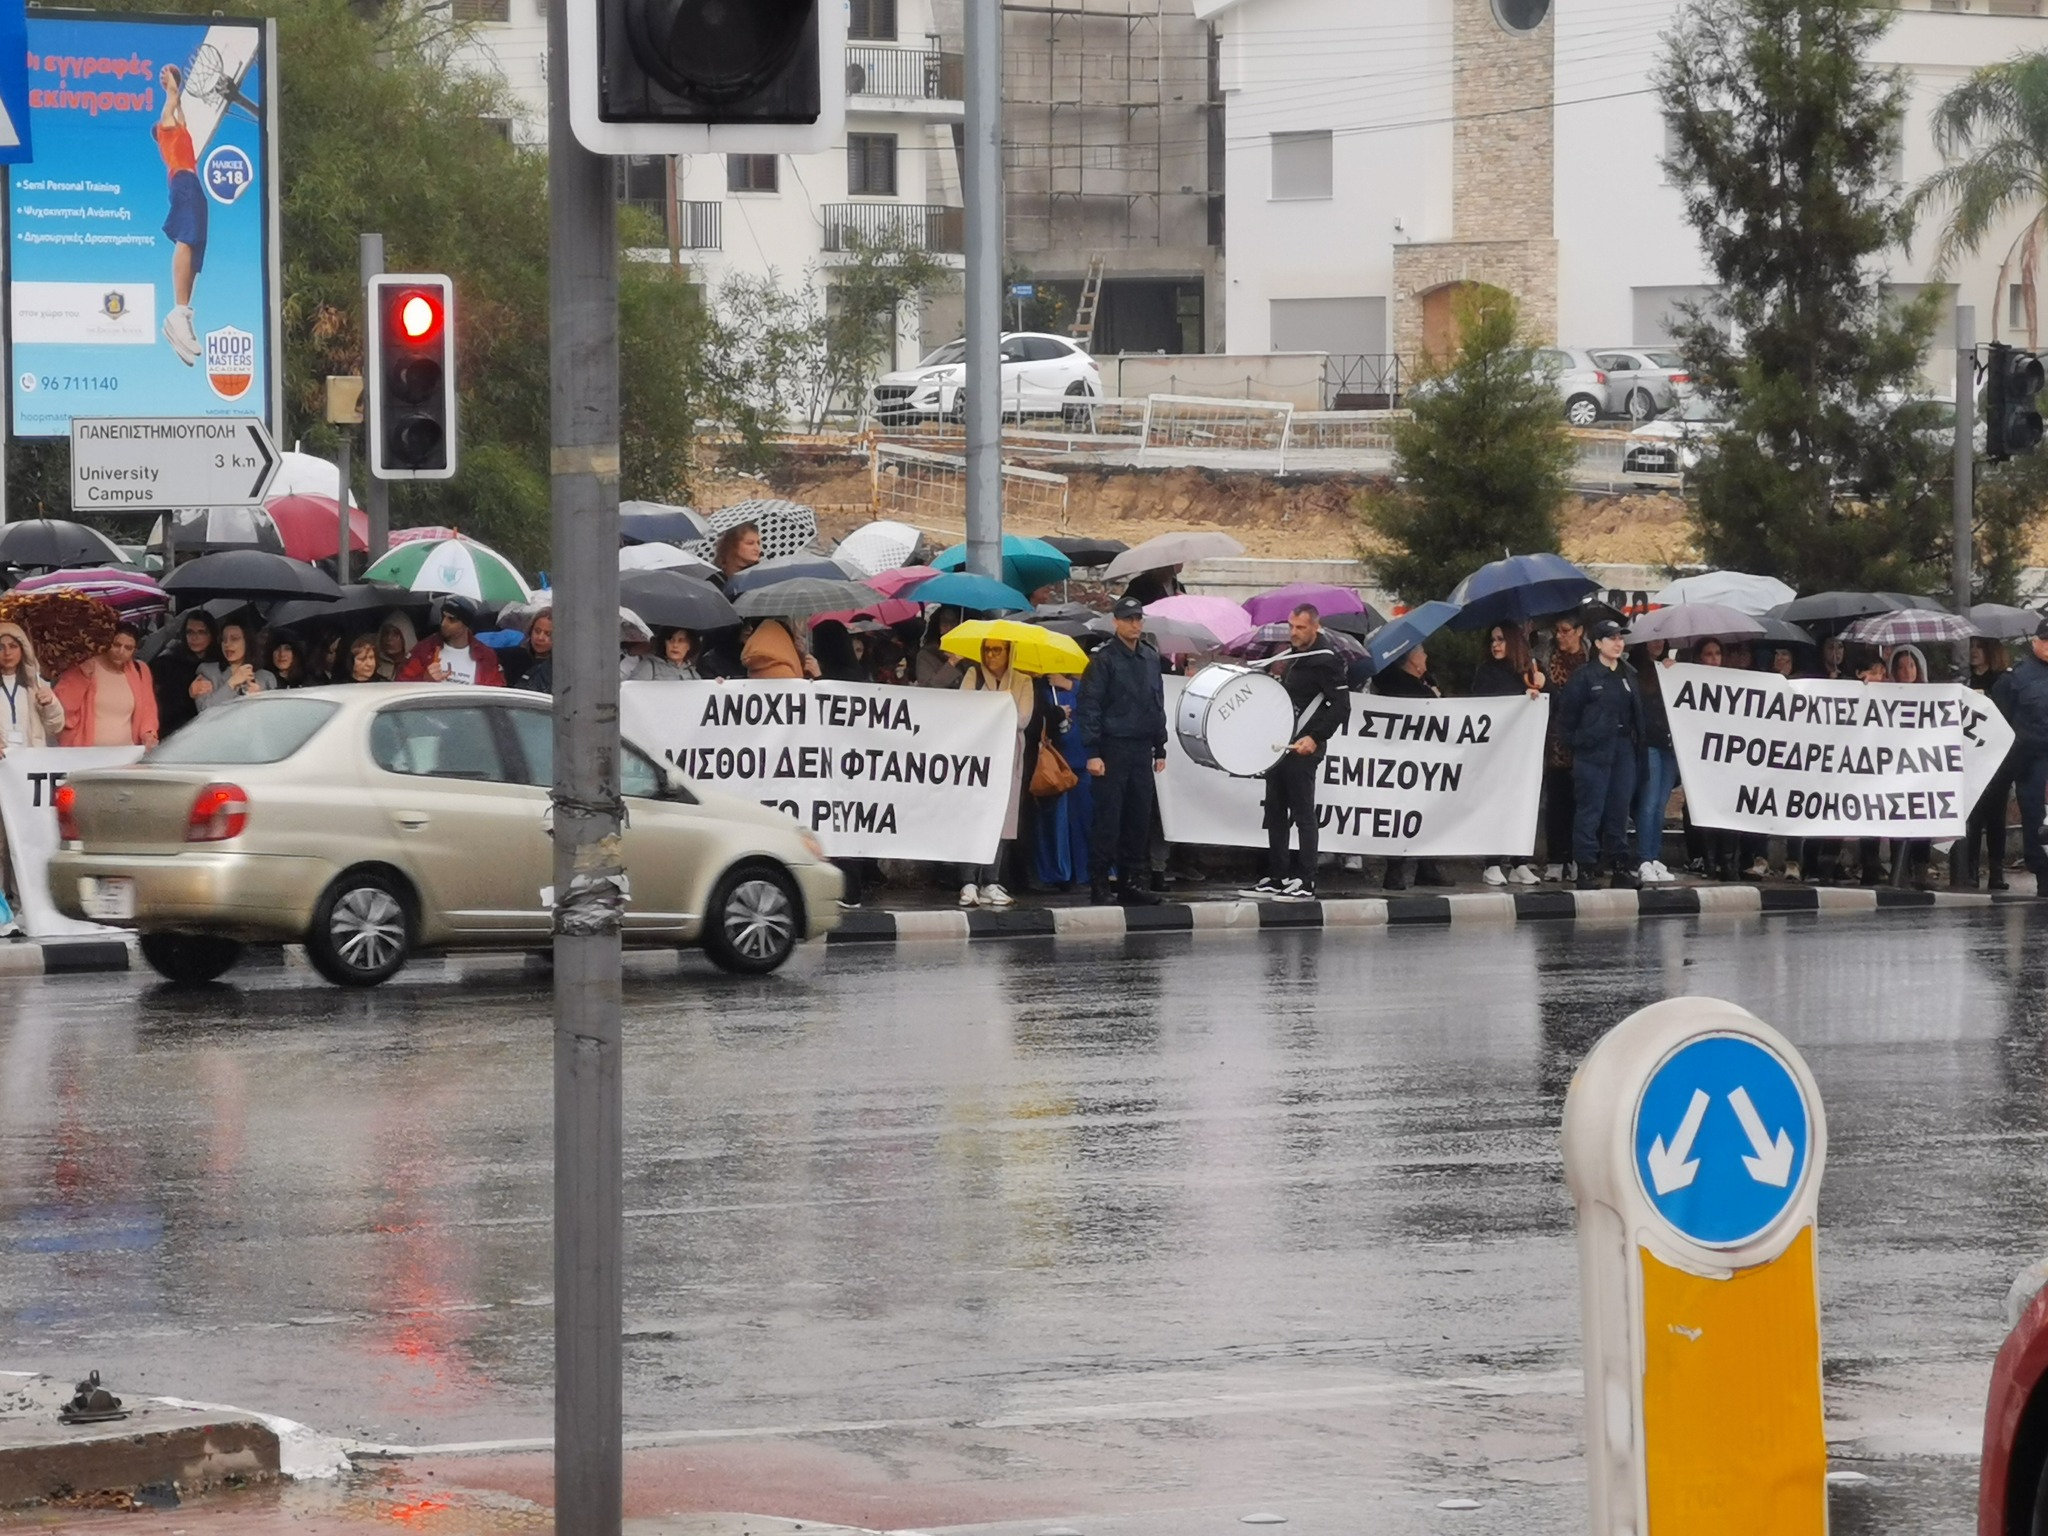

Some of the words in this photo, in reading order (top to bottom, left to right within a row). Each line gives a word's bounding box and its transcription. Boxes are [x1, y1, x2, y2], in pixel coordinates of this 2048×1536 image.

[27, 51, 40, 71] ι
[44, 52, 152, 80] εγγραφές
[29, 79, 153, 117] εκίνησαν!
[22, 179, 45, 190] Semi
[46, 180, 84, 191] Personal
[85, 181, 121, 194] Training
[212, 170, 243, 185] 3-18
[87, 206, 131, 220] Ανάπτυξη
[208, 336, 251, 355] HOOP
[208, 354, 252, 366] MASTERS
[41, 376, 59, 391] 96
[63, 376, 118, 391] 711140
[79, 424, 236, 439] ΠΑΝΕΠΙΣΤΗΜΙΟΥΠΟΛΗ
[79, 466, 159, 482] University
[215, 453, 225, 468] 3
[88, 486, 153, 502] Campus
[700, 693, 806, 727] ΑΝΟΧΗ
[814, 693, 920, 736] ΤΕΡΜΑ,
[1217, 683, 1253, 721] EVAN
[1673, 680, 1860, 727] ΑΝΥΠΑΡΚΤΕΣ
[1358, 709, 1450, 743] ΣΤΗΝ
[1456, 714, 1492, 744] Α2
[1700, 731, 1834, 773] ΠΡΟΕΔΡΕ
[773, 747, 832, 779] ΔΕΝ
[840, 748, 991, 788] ΦΤΑΝΟΥΝ
[1323, 755, 1463, 792] ΕΜΙΖΟΥΝ
[811, 800, 897, 835] ΡΕΥΜΑ
[1735, 785, 1778, 817] ΝΑ
[1785, 790, 1959, 821] ΒΟΗΘΗΣΕΙΣ
